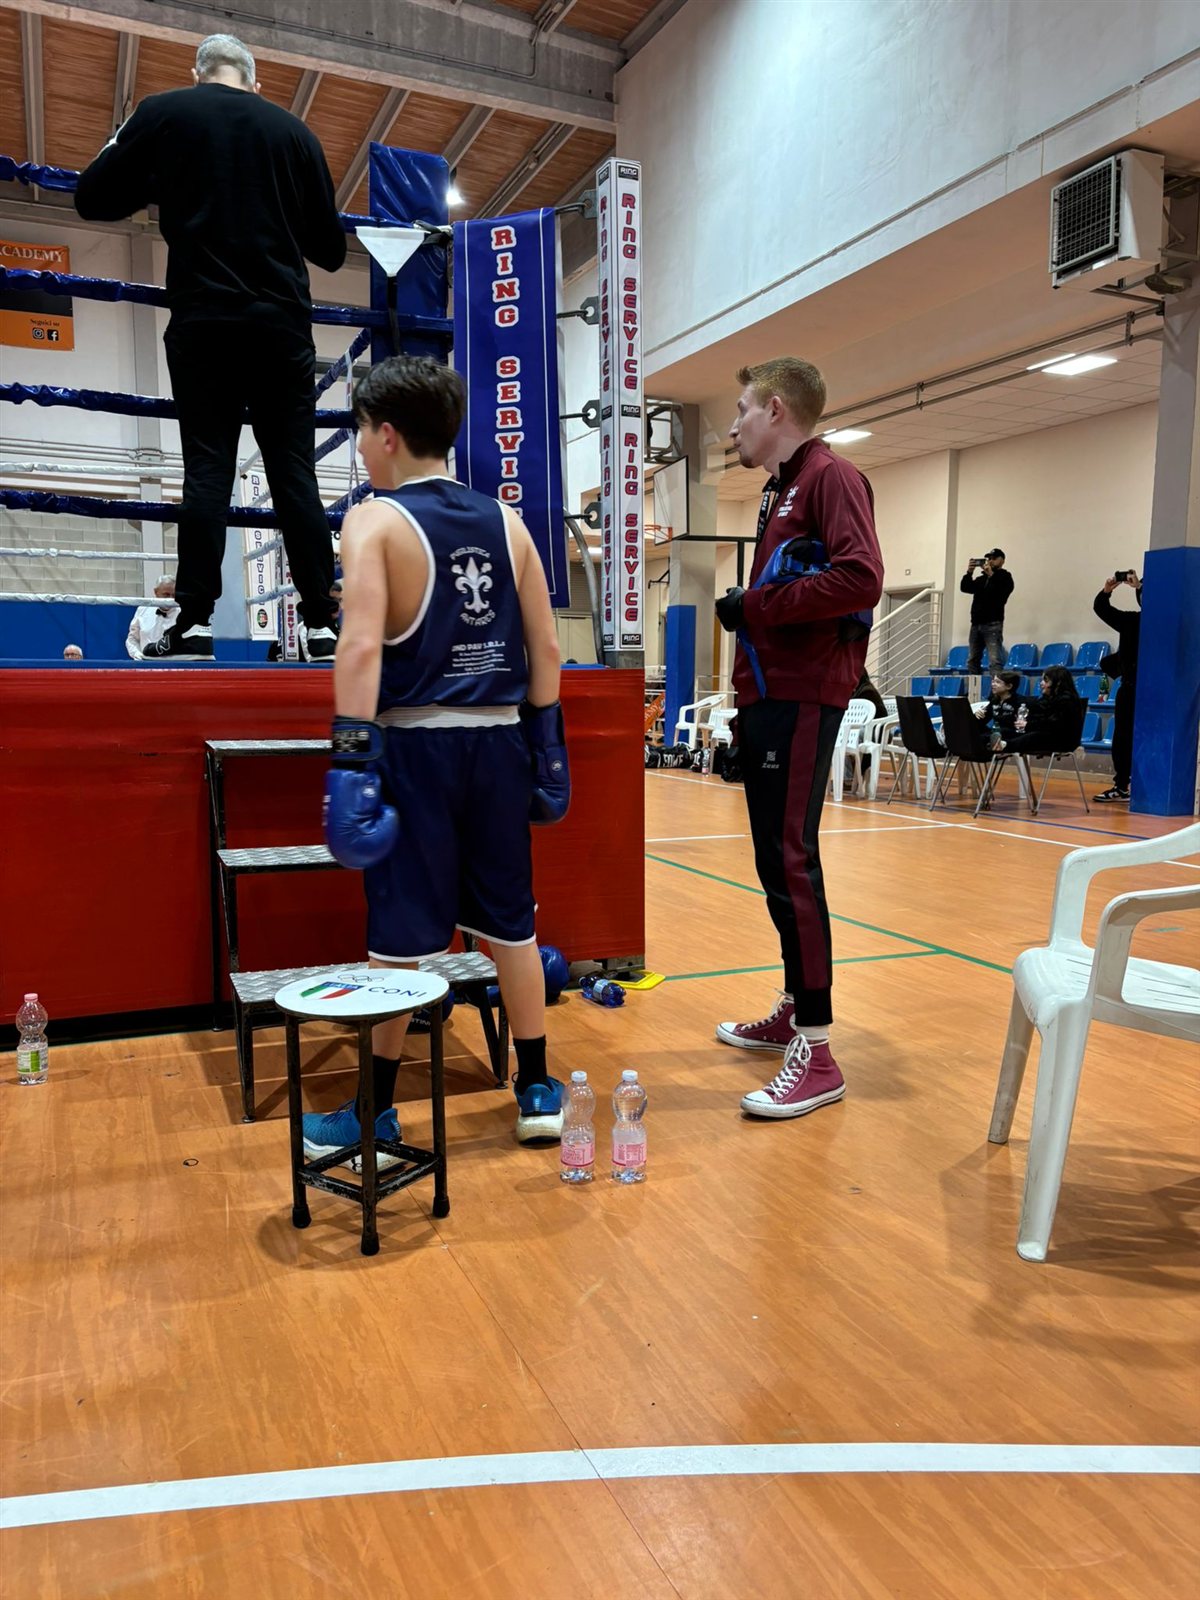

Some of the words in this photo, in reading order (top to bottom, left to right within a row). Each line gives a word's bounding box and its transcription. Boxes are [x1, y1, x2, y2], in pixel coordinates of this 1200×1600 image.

[620, 166, 637, 175] RING
[600, 195, 608, 262] RING
[621, 193, 637, 259] RING
[491, 225, 520, 327] RING
[601, 278, 610, 392] SERVICE
[623, 277, 638, 390] SERVICE
[495, 356, 524, 518] SERVIC
[623, 405, 640, 413] RING
[603, 434, 611, 497] RING
[624, 432, 638, 496] RING
[604, 514, 612, 622] SERVICE
[624, 513, 639, 622] SERVICE
[623, 634, 640, 642] RING
[368, 986, 428, 998] CONI
